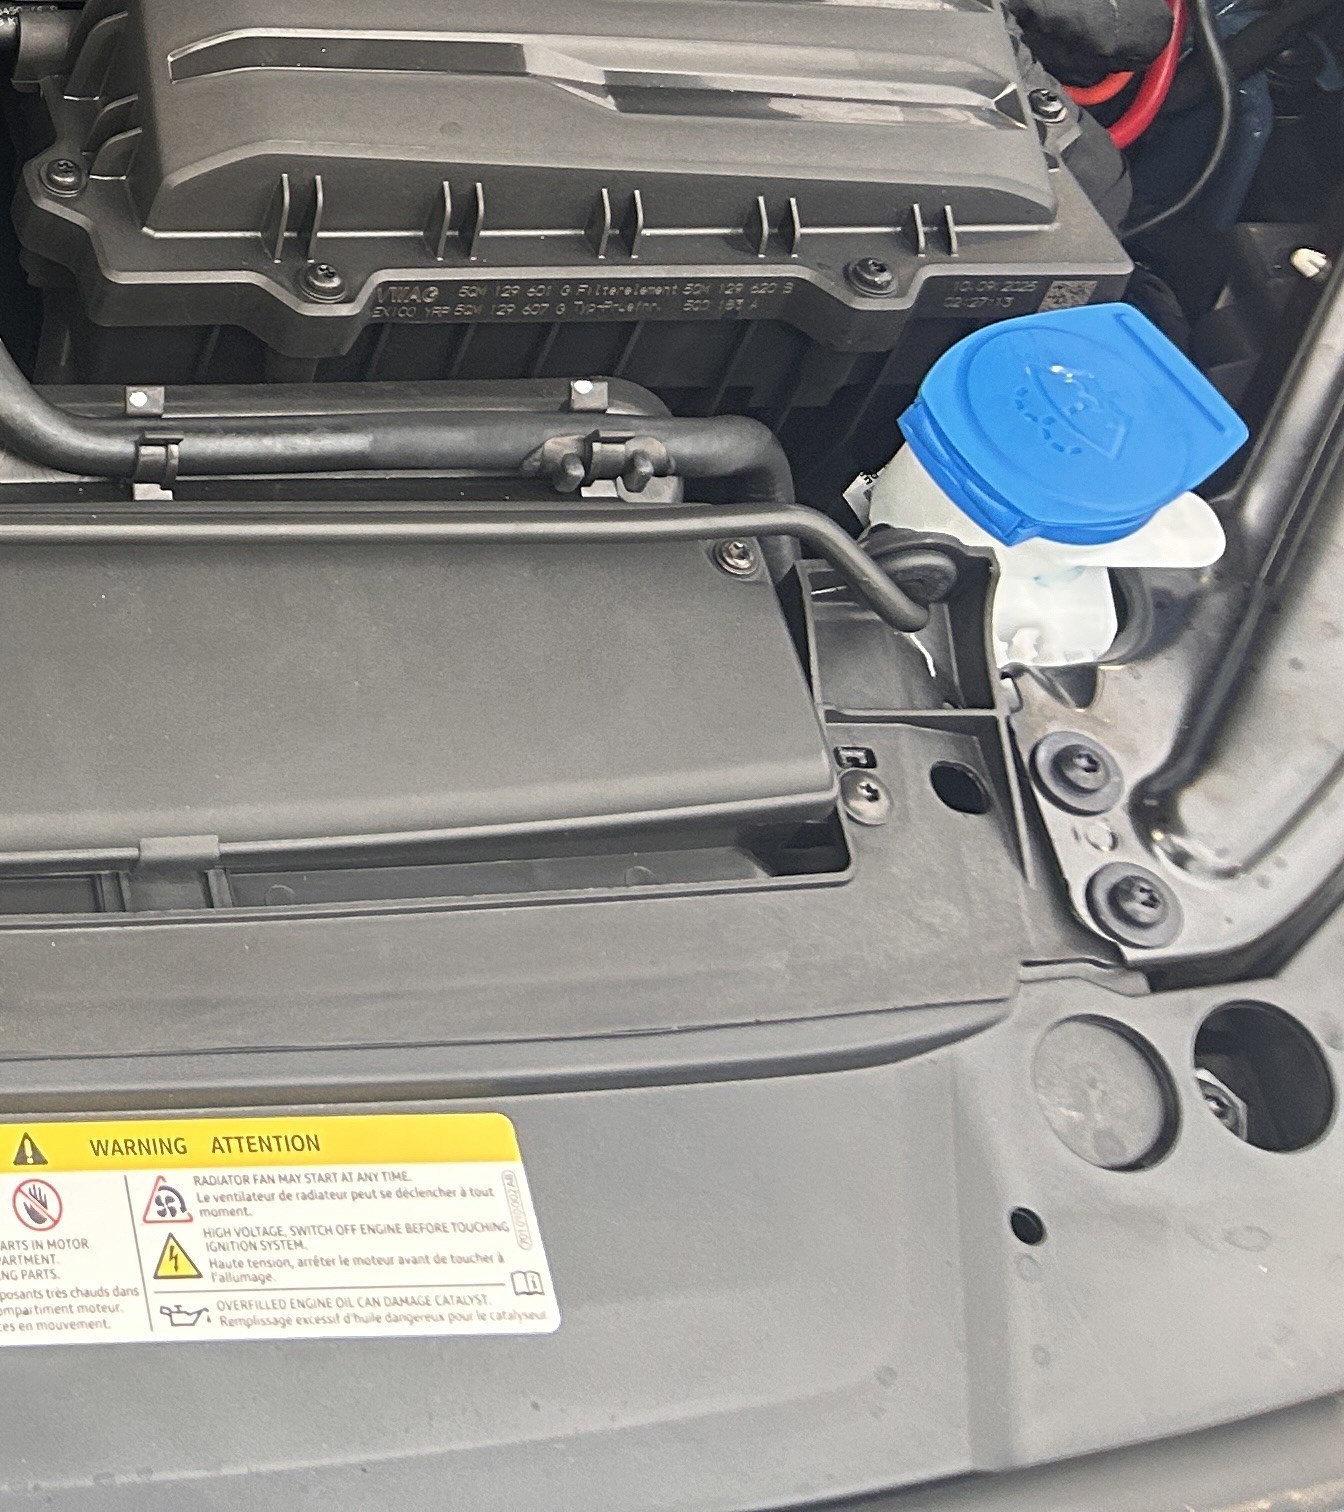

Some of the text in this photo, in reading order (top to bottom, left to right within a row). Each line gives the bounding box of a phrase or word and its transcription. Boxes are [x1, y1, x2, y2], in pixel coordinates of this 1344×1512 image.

[89, 1134, 321, 1157] WARNING ATTENTION
[192, 1174, 250, 1186] RADIATOR
[252, 1173, 276, 1184] FAN
[277, 1173, 301, 1184] MAY
[303, 1171, 338, 1184] START
[340, 1171, 353, 1182] AT
[356, 1171, 378, 1182] ANY
[195, 1191, 211, 1204] Le
[212, 1190, 275, 1203] ventilateur
[278, 1189, 293, 1202] de
[295, 1188, 348, 1201] radiateur
[350, 1188, 378, 1203] peut
[379, 1189, 393, 1200] se
[394, 1186, 456, 1199] déclencher
[468, 1186, 495, 1198] tout
[198, 1206, 253, 1217] moment.
[202, 1227, 232, 1239] HIGH
[287, 1224, 333, 1238] SWITCH
[335, 1223, 357, 1236] OFF
[359, 1222, 403, 1235] ENGINE
[404, 1222, 450, 1234] BEFORE
[450, 1220, 510, 1233] TOUCHING
[30, 1239, 44, 1250] IN
[46, 1237, 89, 1250] MOTOR
[205, 1239, 258, 1252] IGNITION
[208, 1257, 244, 1270] Haute
[338, 1254, 350, 1267] le
[352, 1255, 394, 1266] moteur
[397, 1254, 431, 1265] avant
[432, 1252, 448, 1264] de
[449, 1252, 494, 1264] toucher
[45, 1286, 68, 1299] très
[69, 1285, 110, 1299] chauds
[111, 1285, 140, 1298] dans
[216, 1298, 287, 1312] OVERFILLED
[289, 1297, 333, 1310] ENGINE
[334, 1296, 355, 1310] OIL
[356, 1296, 381, 1308] CAN
[382, 1294, 432, 1307] DAMAGE
[342, 1311, 382, 1324] d'huile
[383, 1311, 445, 1326] dangereux
[475, 1309, 489, 1321] le
[18, 1322, 34, 1332] en
